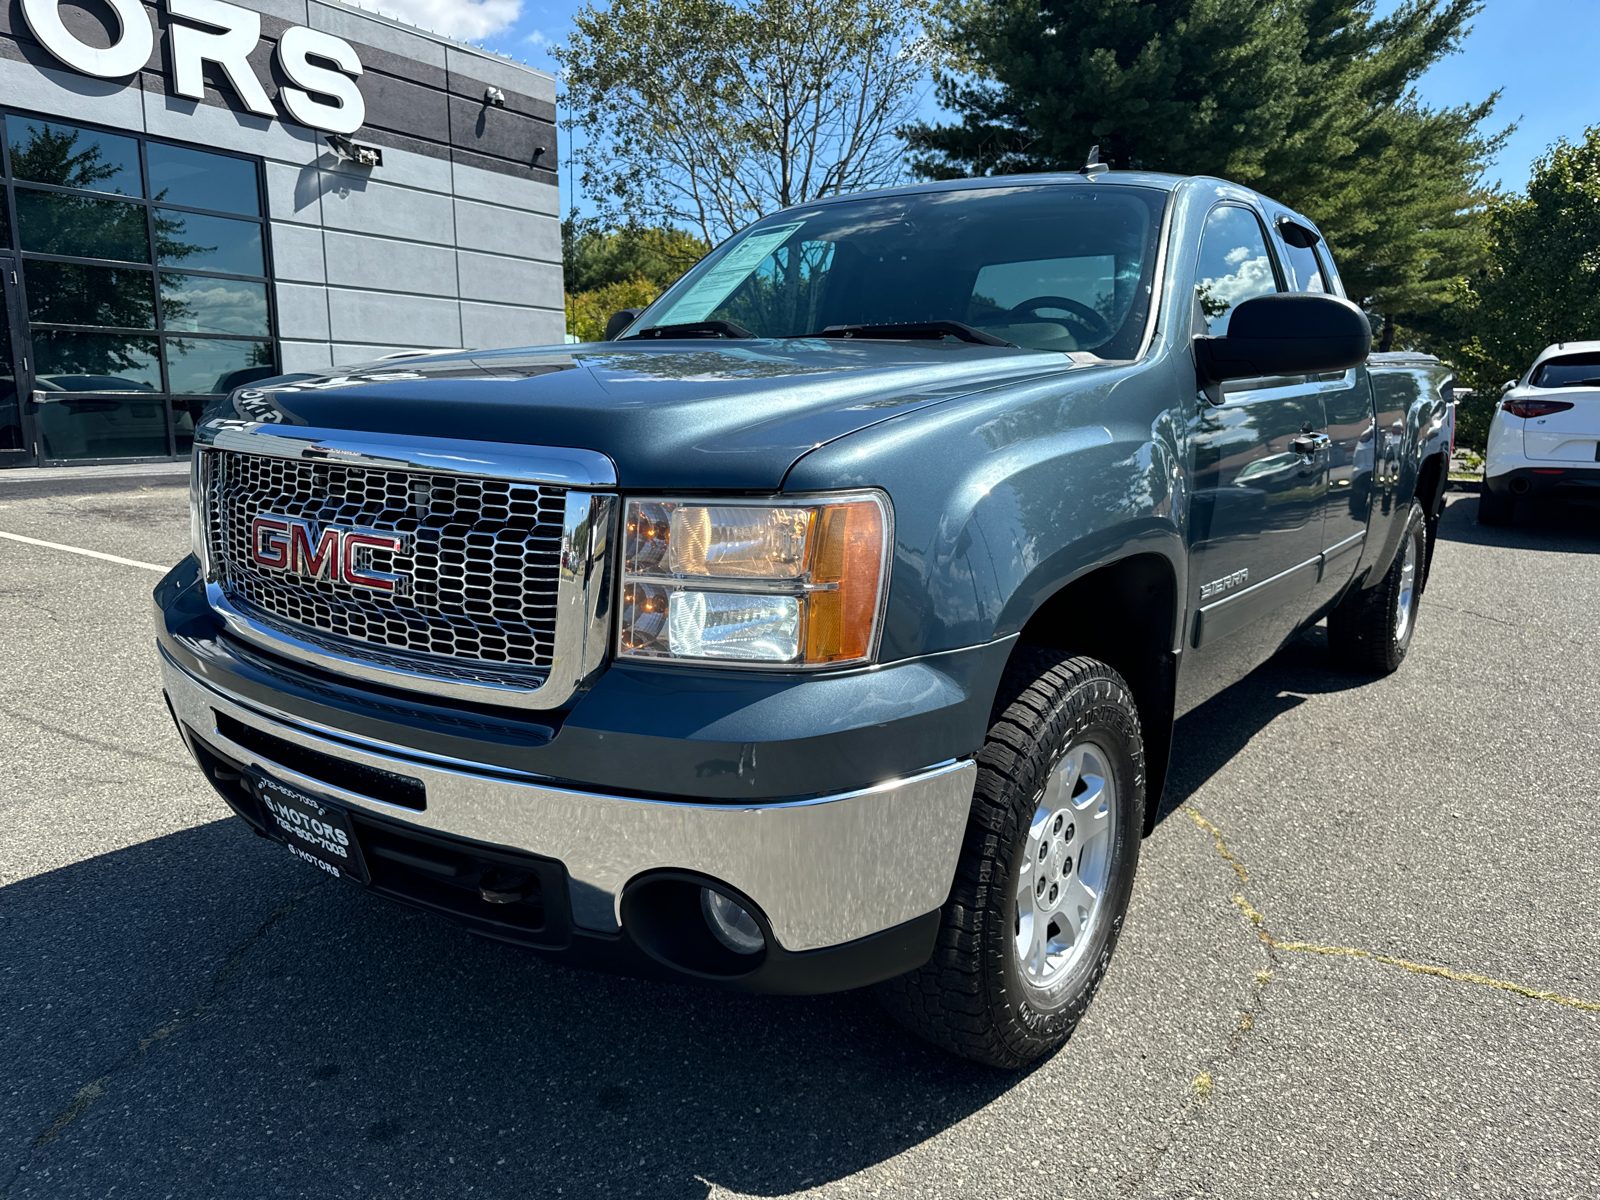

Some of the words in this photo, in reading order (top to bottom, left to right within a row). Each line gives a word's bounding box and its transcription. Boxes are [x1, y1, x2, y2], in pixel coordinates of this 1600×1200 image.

[252, 513, 404, 594] GMC
[1200, 567, 1249, 600] SIERRA
[273, 813, 348, 858] 732-800-7003
